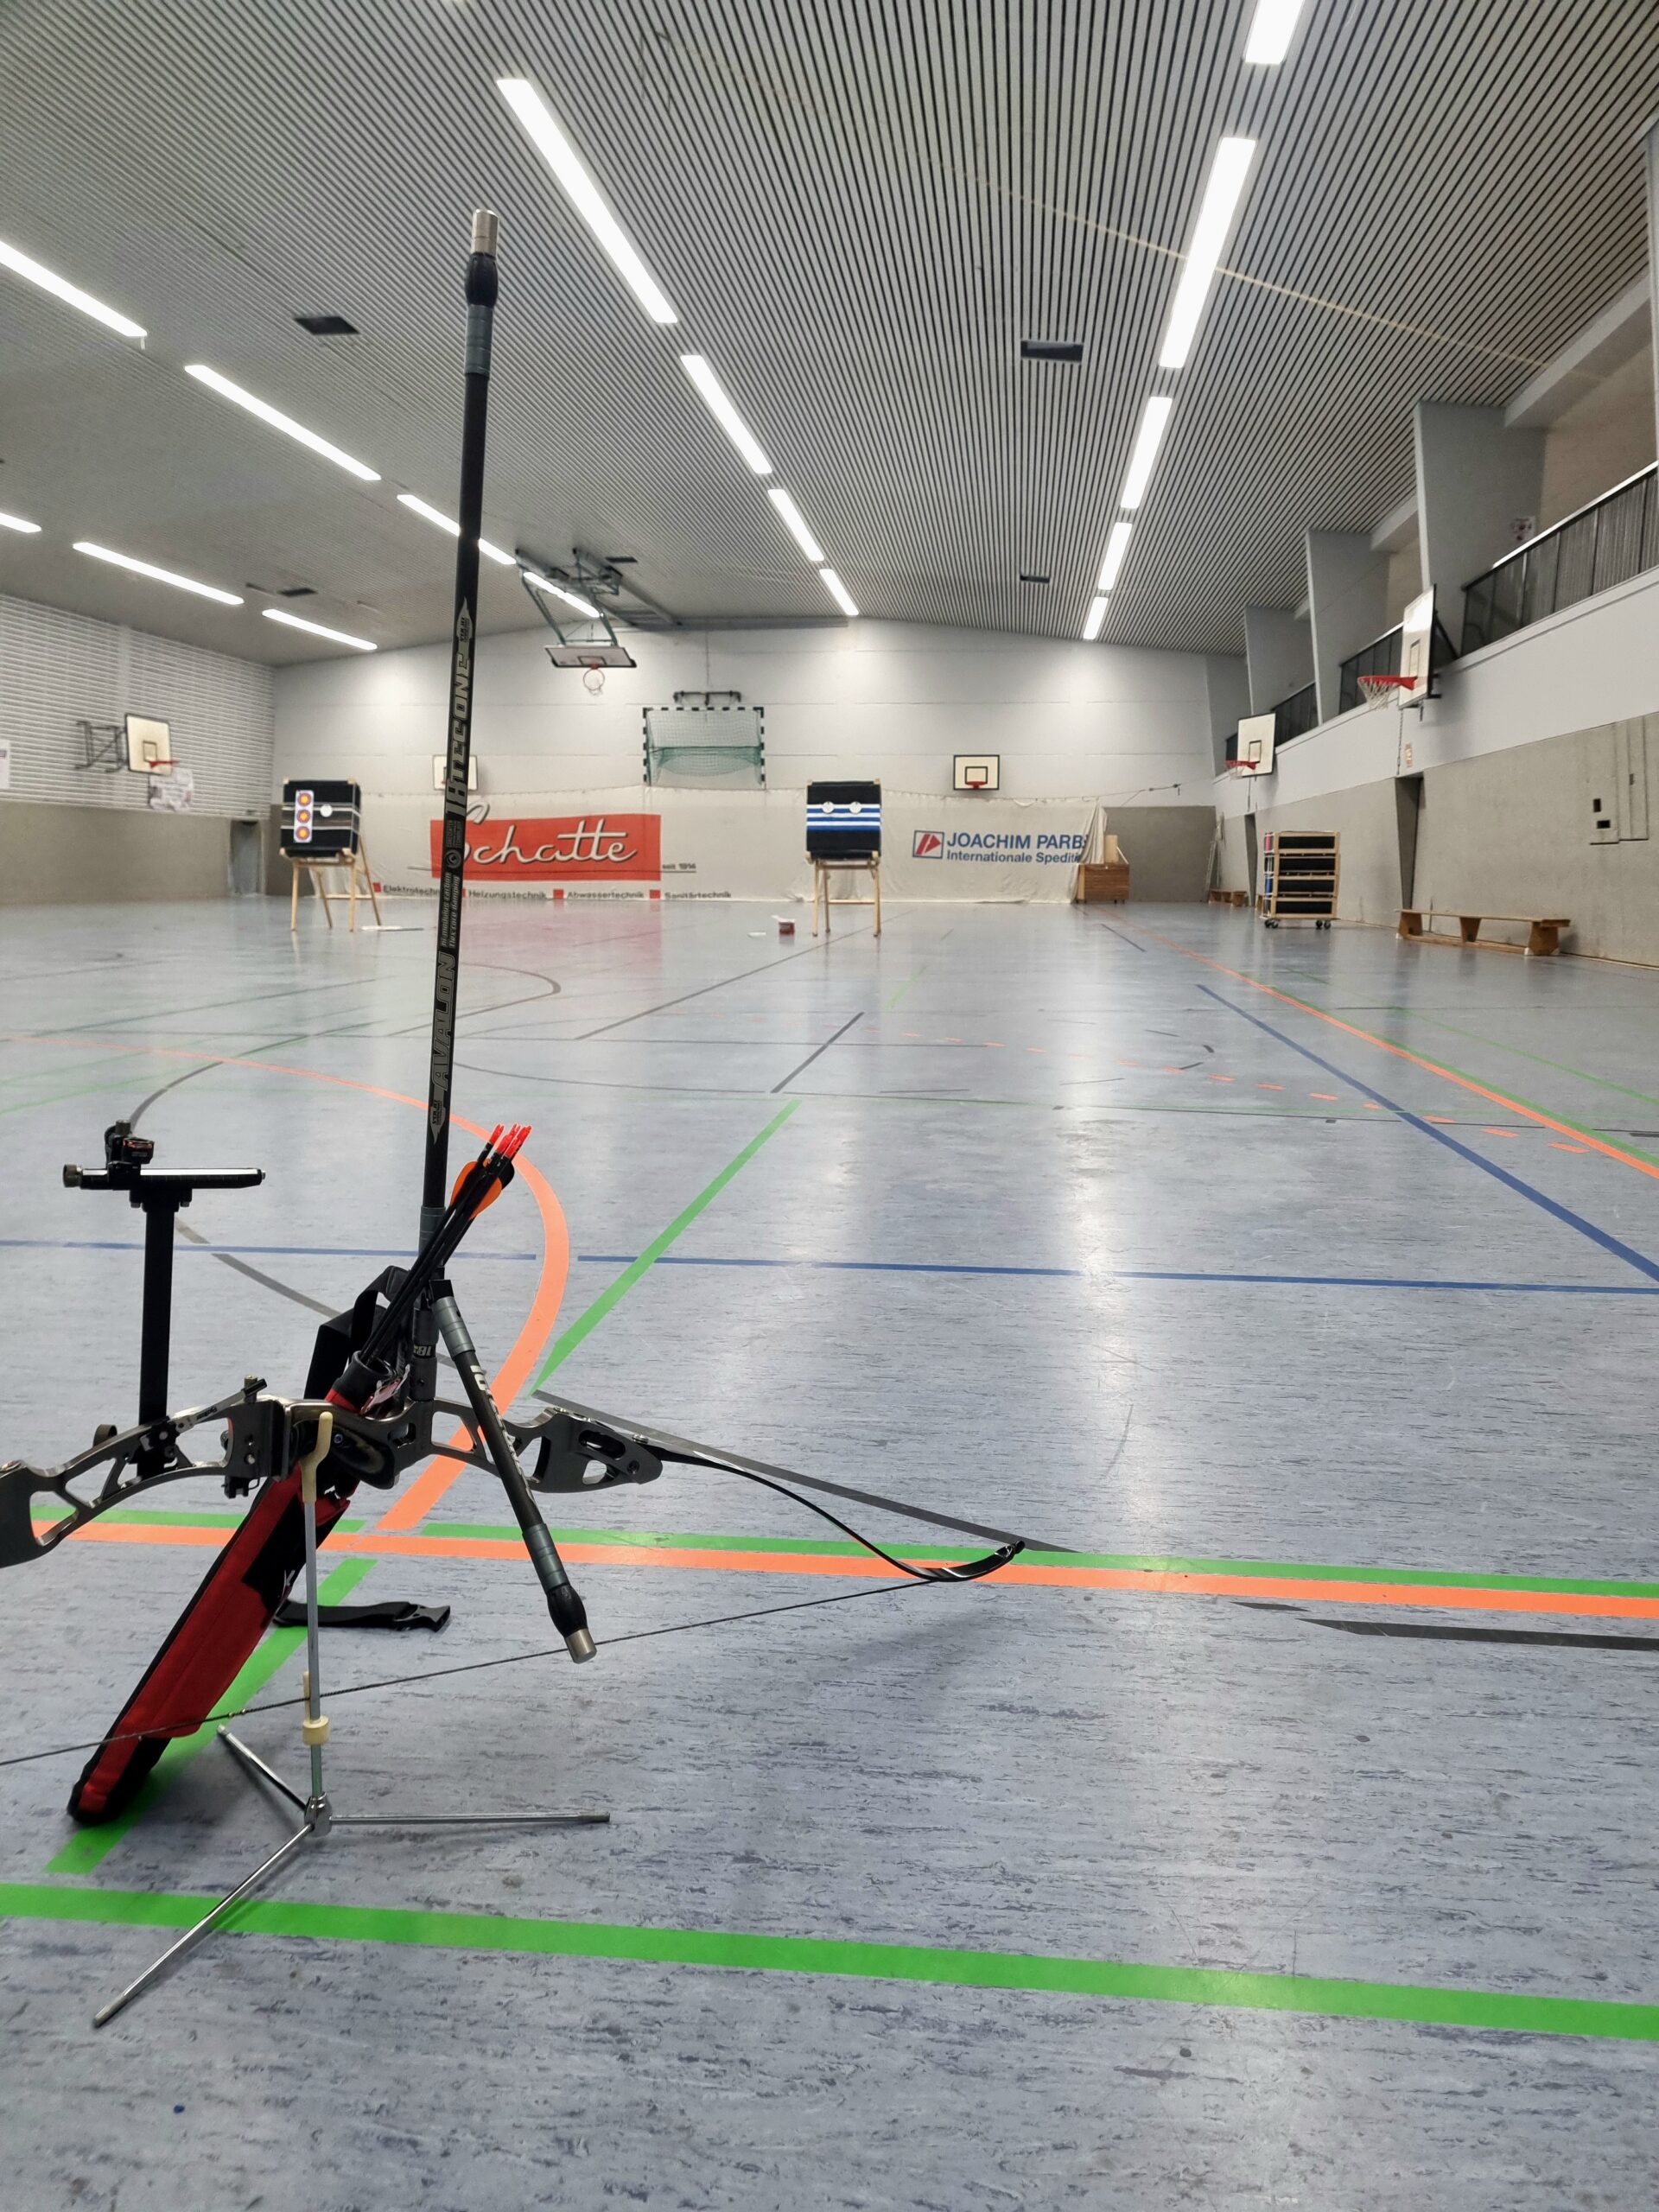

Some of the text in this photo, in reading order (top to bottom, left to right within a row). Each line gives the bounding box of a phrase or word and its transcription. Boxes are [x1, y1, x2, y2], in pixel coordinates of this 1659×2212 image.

[947, 832, 1031, 849] JOACHIM
[947, 850, 1033, 863] Internationale
[432, 951, 455, 1091] AVALON
